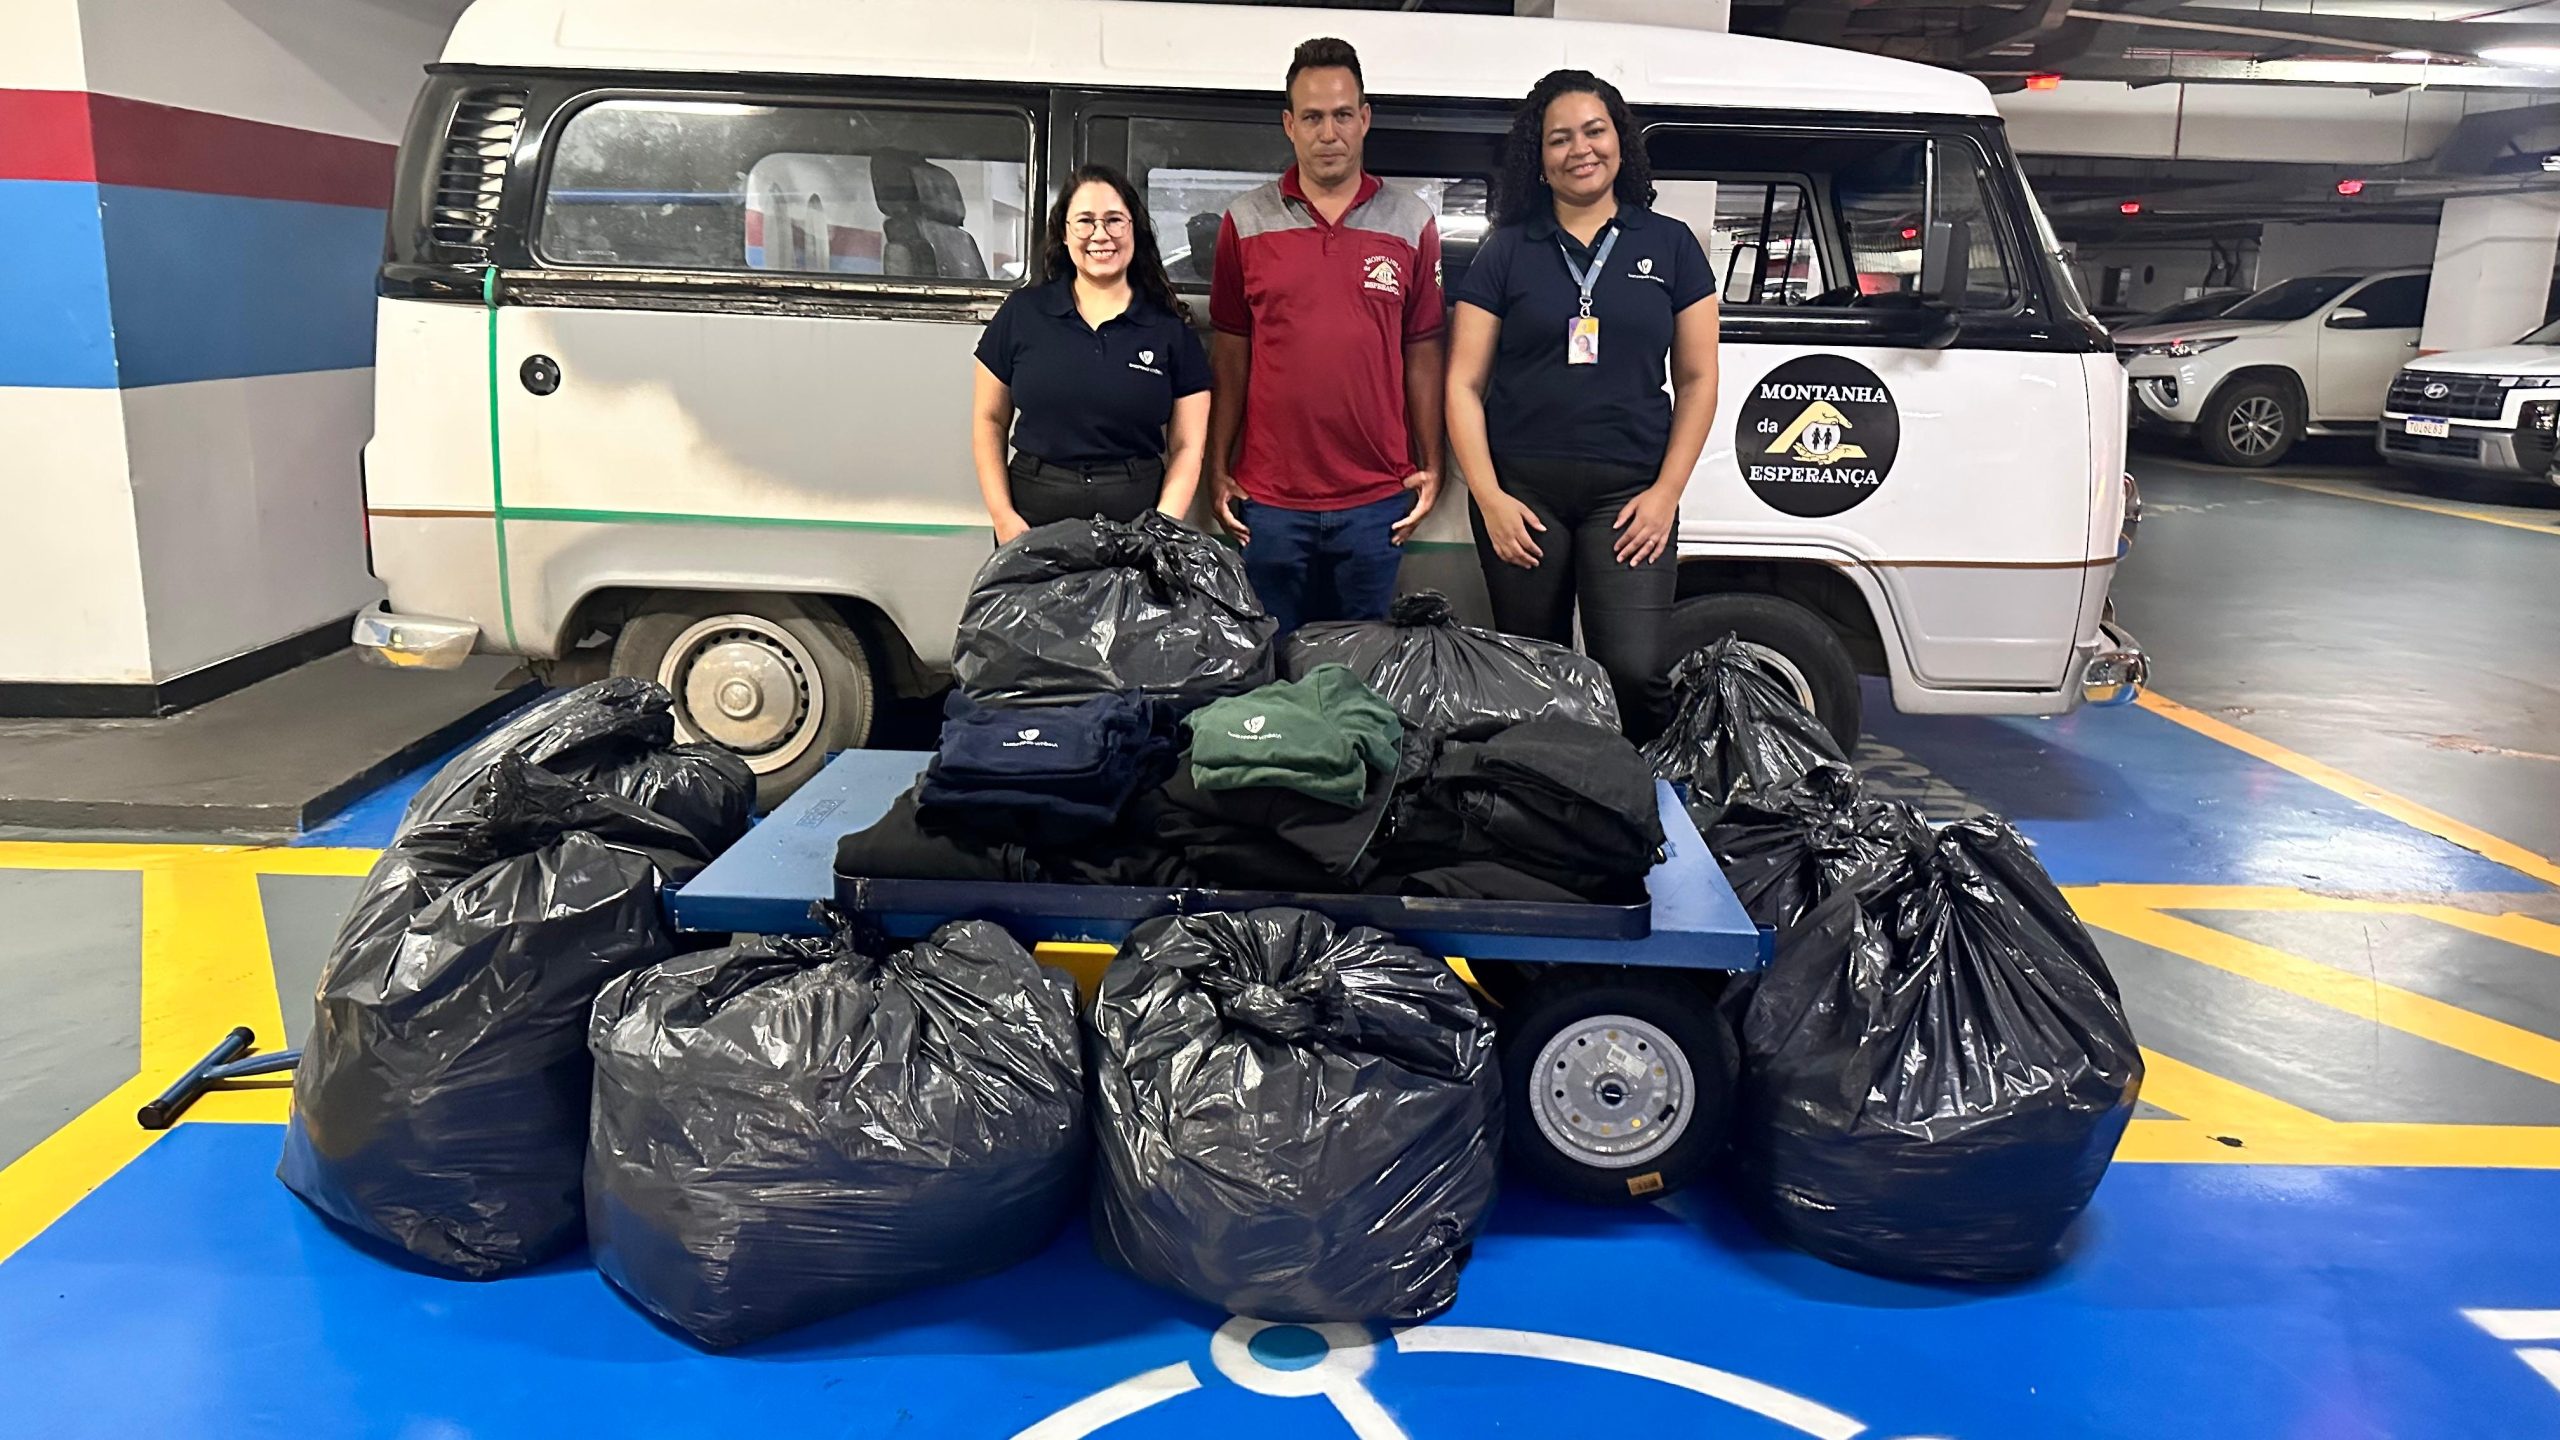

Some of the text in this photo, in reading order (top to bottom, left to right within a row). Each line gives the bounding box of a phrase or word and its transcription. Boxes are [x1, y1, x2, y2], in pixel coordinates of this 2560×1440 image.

[1760, 383, 1888, 404] MONTANHA
[1756, 418, 1779, 434] da
[1749, 465, 1880, 488] ESPERANÇA
